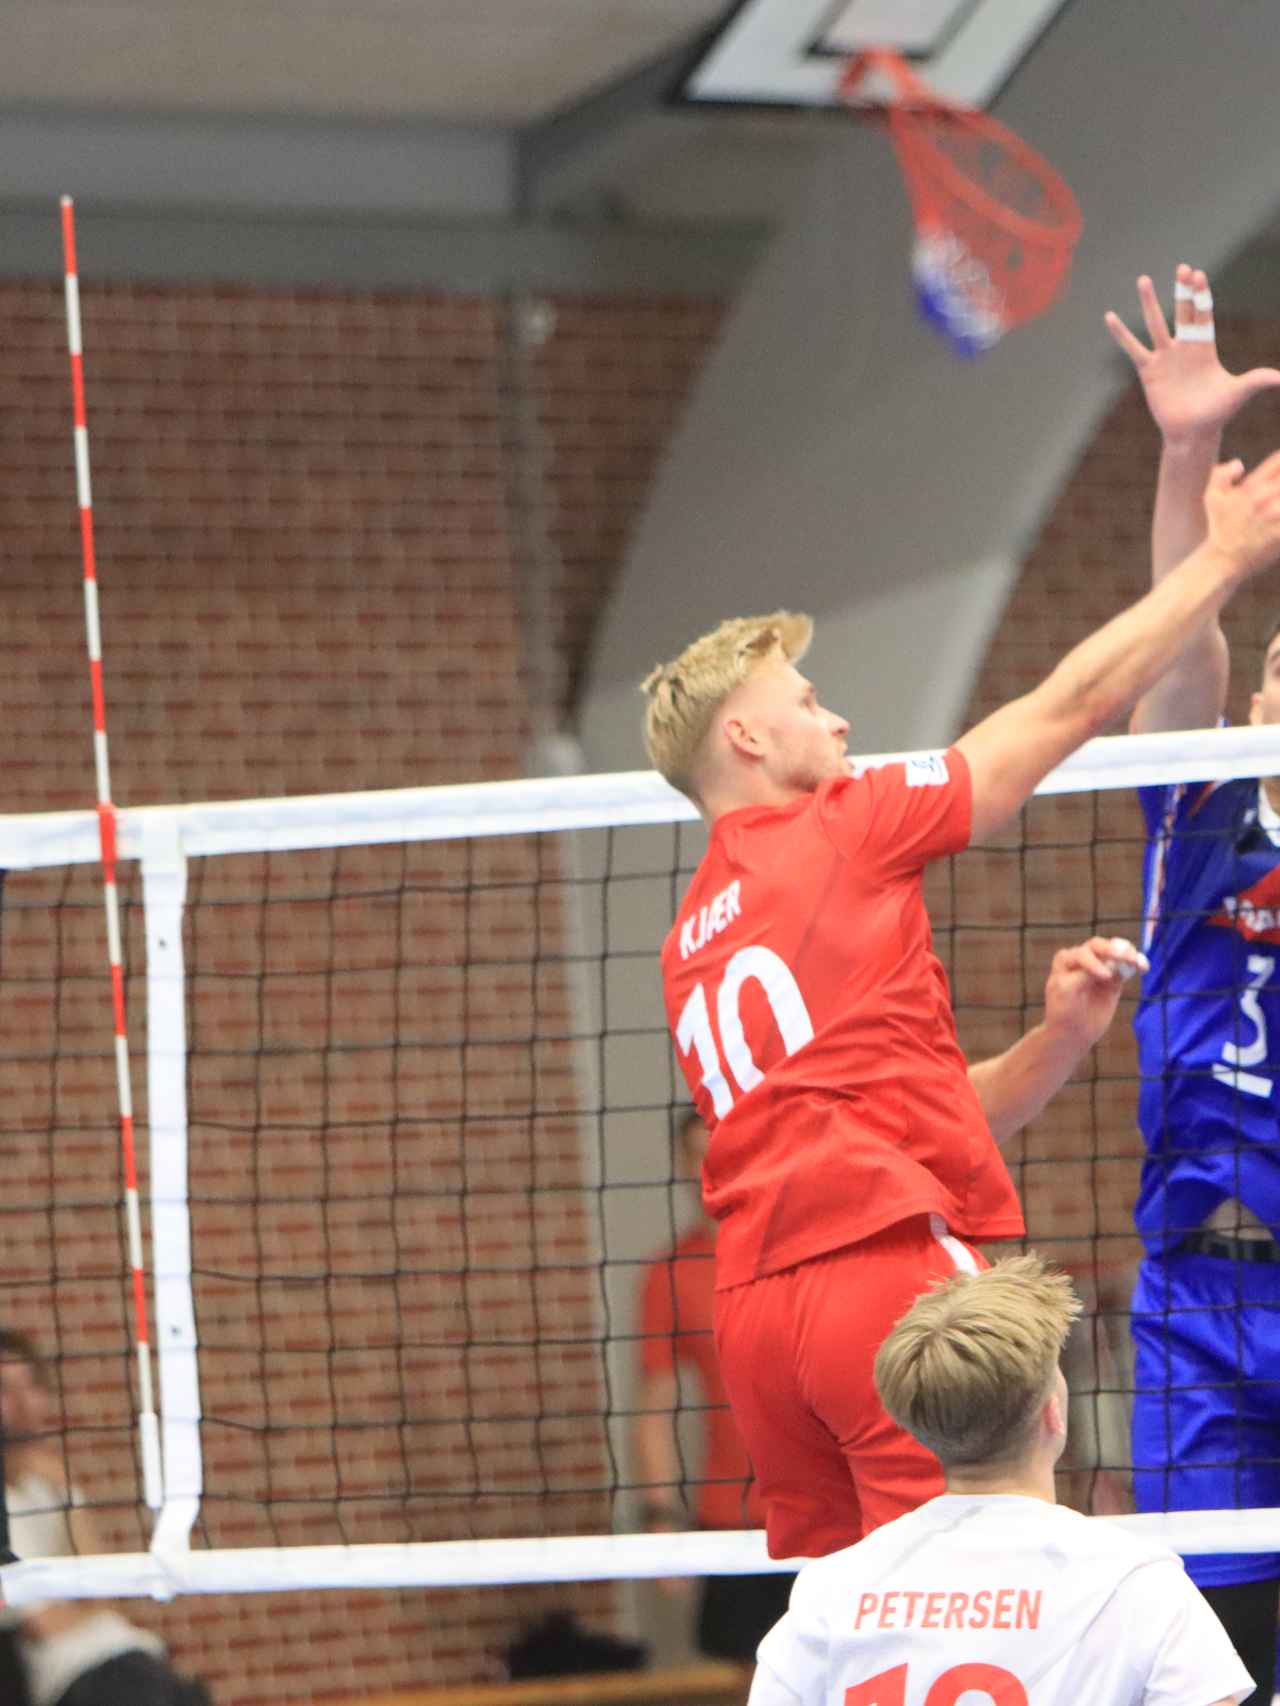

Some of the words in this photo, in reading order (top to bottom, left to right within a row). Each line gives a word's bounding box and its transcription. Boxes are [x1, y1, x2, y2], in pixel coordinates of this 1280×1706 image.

[679, 880, 742, 960] KJÆR
[676, 945, 814, 1120] 10
[854, 1589, 1043, 1630] PETERSEN
